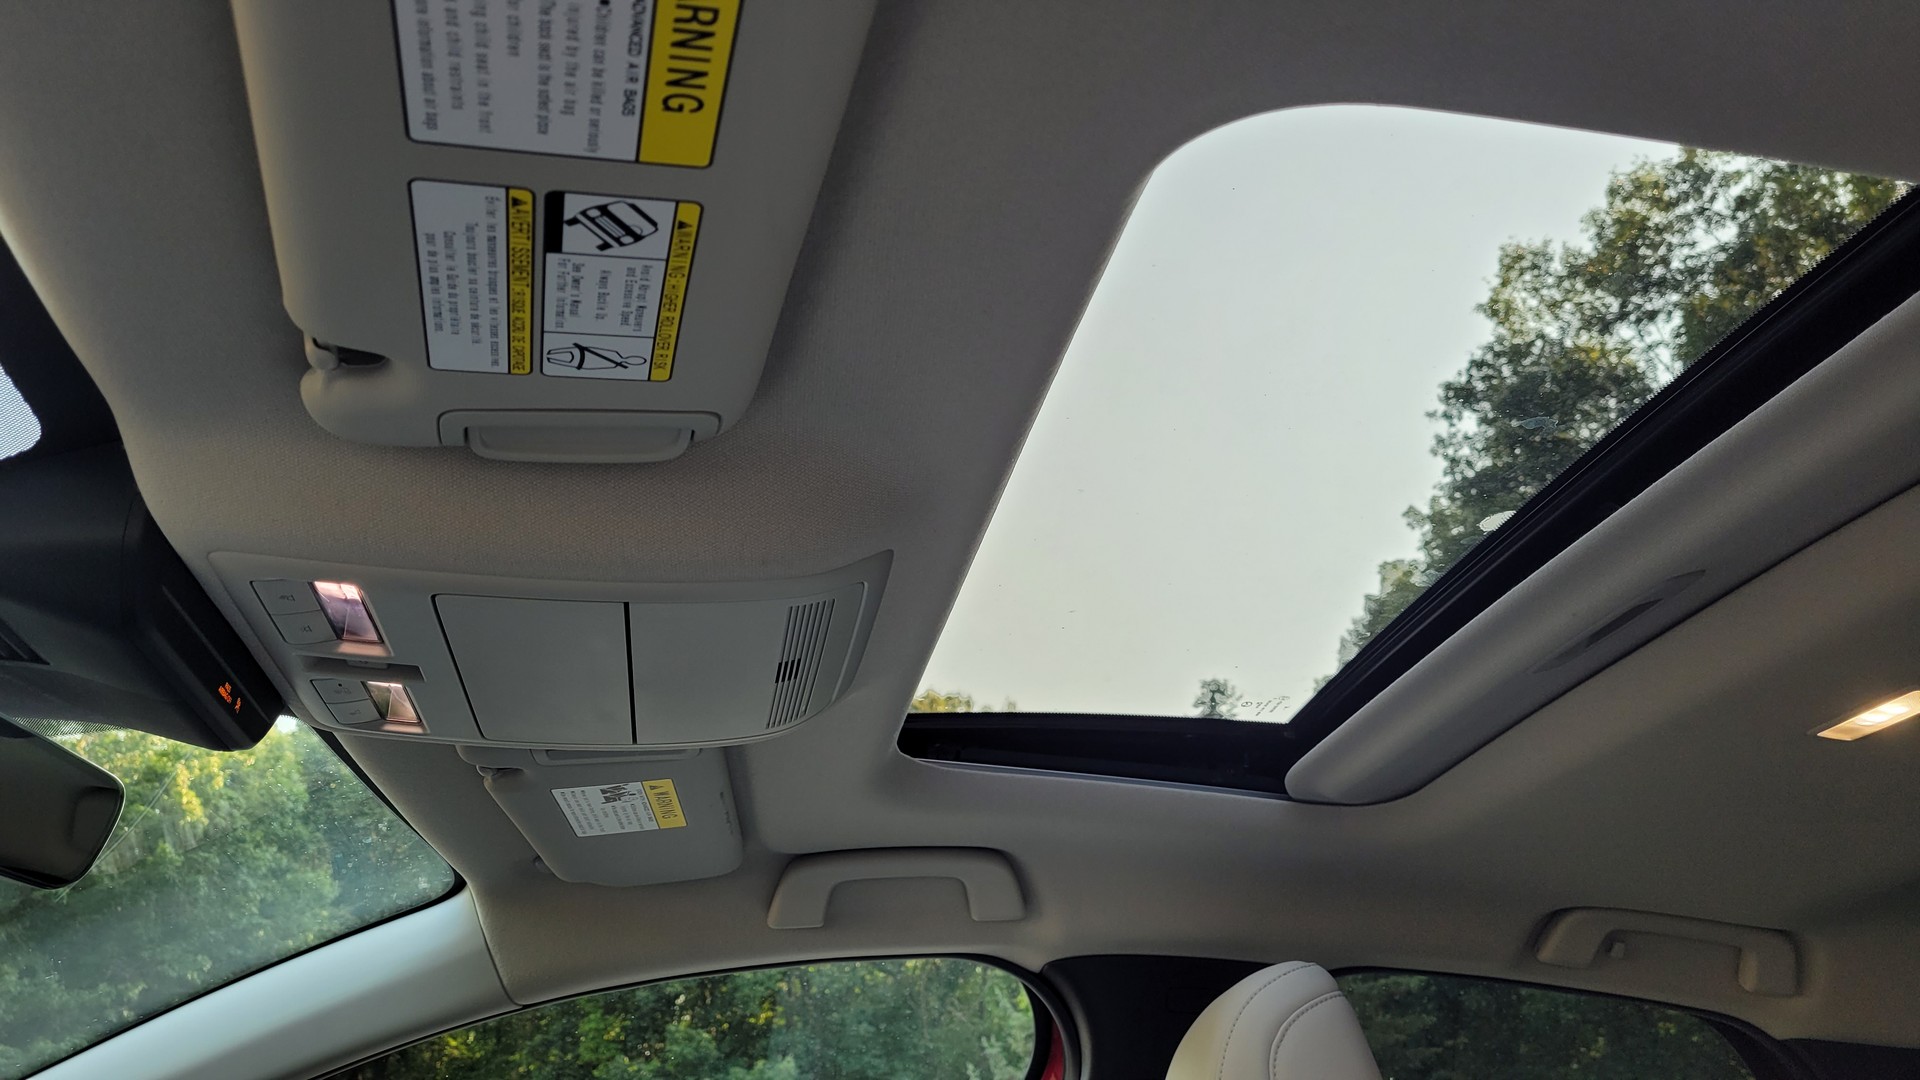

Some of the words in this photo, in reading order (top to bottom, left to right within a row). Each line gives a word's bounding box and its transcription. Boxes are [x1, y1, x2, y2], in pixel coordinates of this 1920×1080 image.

[562, 46, 578, 57] by
[592, 50, 605, 64] can
[660, 0, 720, 114] RNING
[565, 62, 578, 77] the
[591, 68, 605, 78] be
[626, 62, 639, 83] AIR
[560, 99, 576, 116] bag
[622, 89, 637, 116] BAGS
[584, 118, 600, 152] seriously
[571, 263, 585, 274] See
[626, 267, 637, 278] and
[638, 265, 653, 283] Avoid
[596, 270, 612, 289] Always
[596, 292, 610, 311] Buckle
[661, 284, 681, 313] HIGHER
[569, 300, 582, 318] Manual
[512, 335, 525, 343] DE
[656, 316, 676, 350] ROLLOVER
[512, 346, 526, 371] CAPOTAGE
[653, 353, 670, 371] RISK
[653, 790, 678, 819] WARNING
